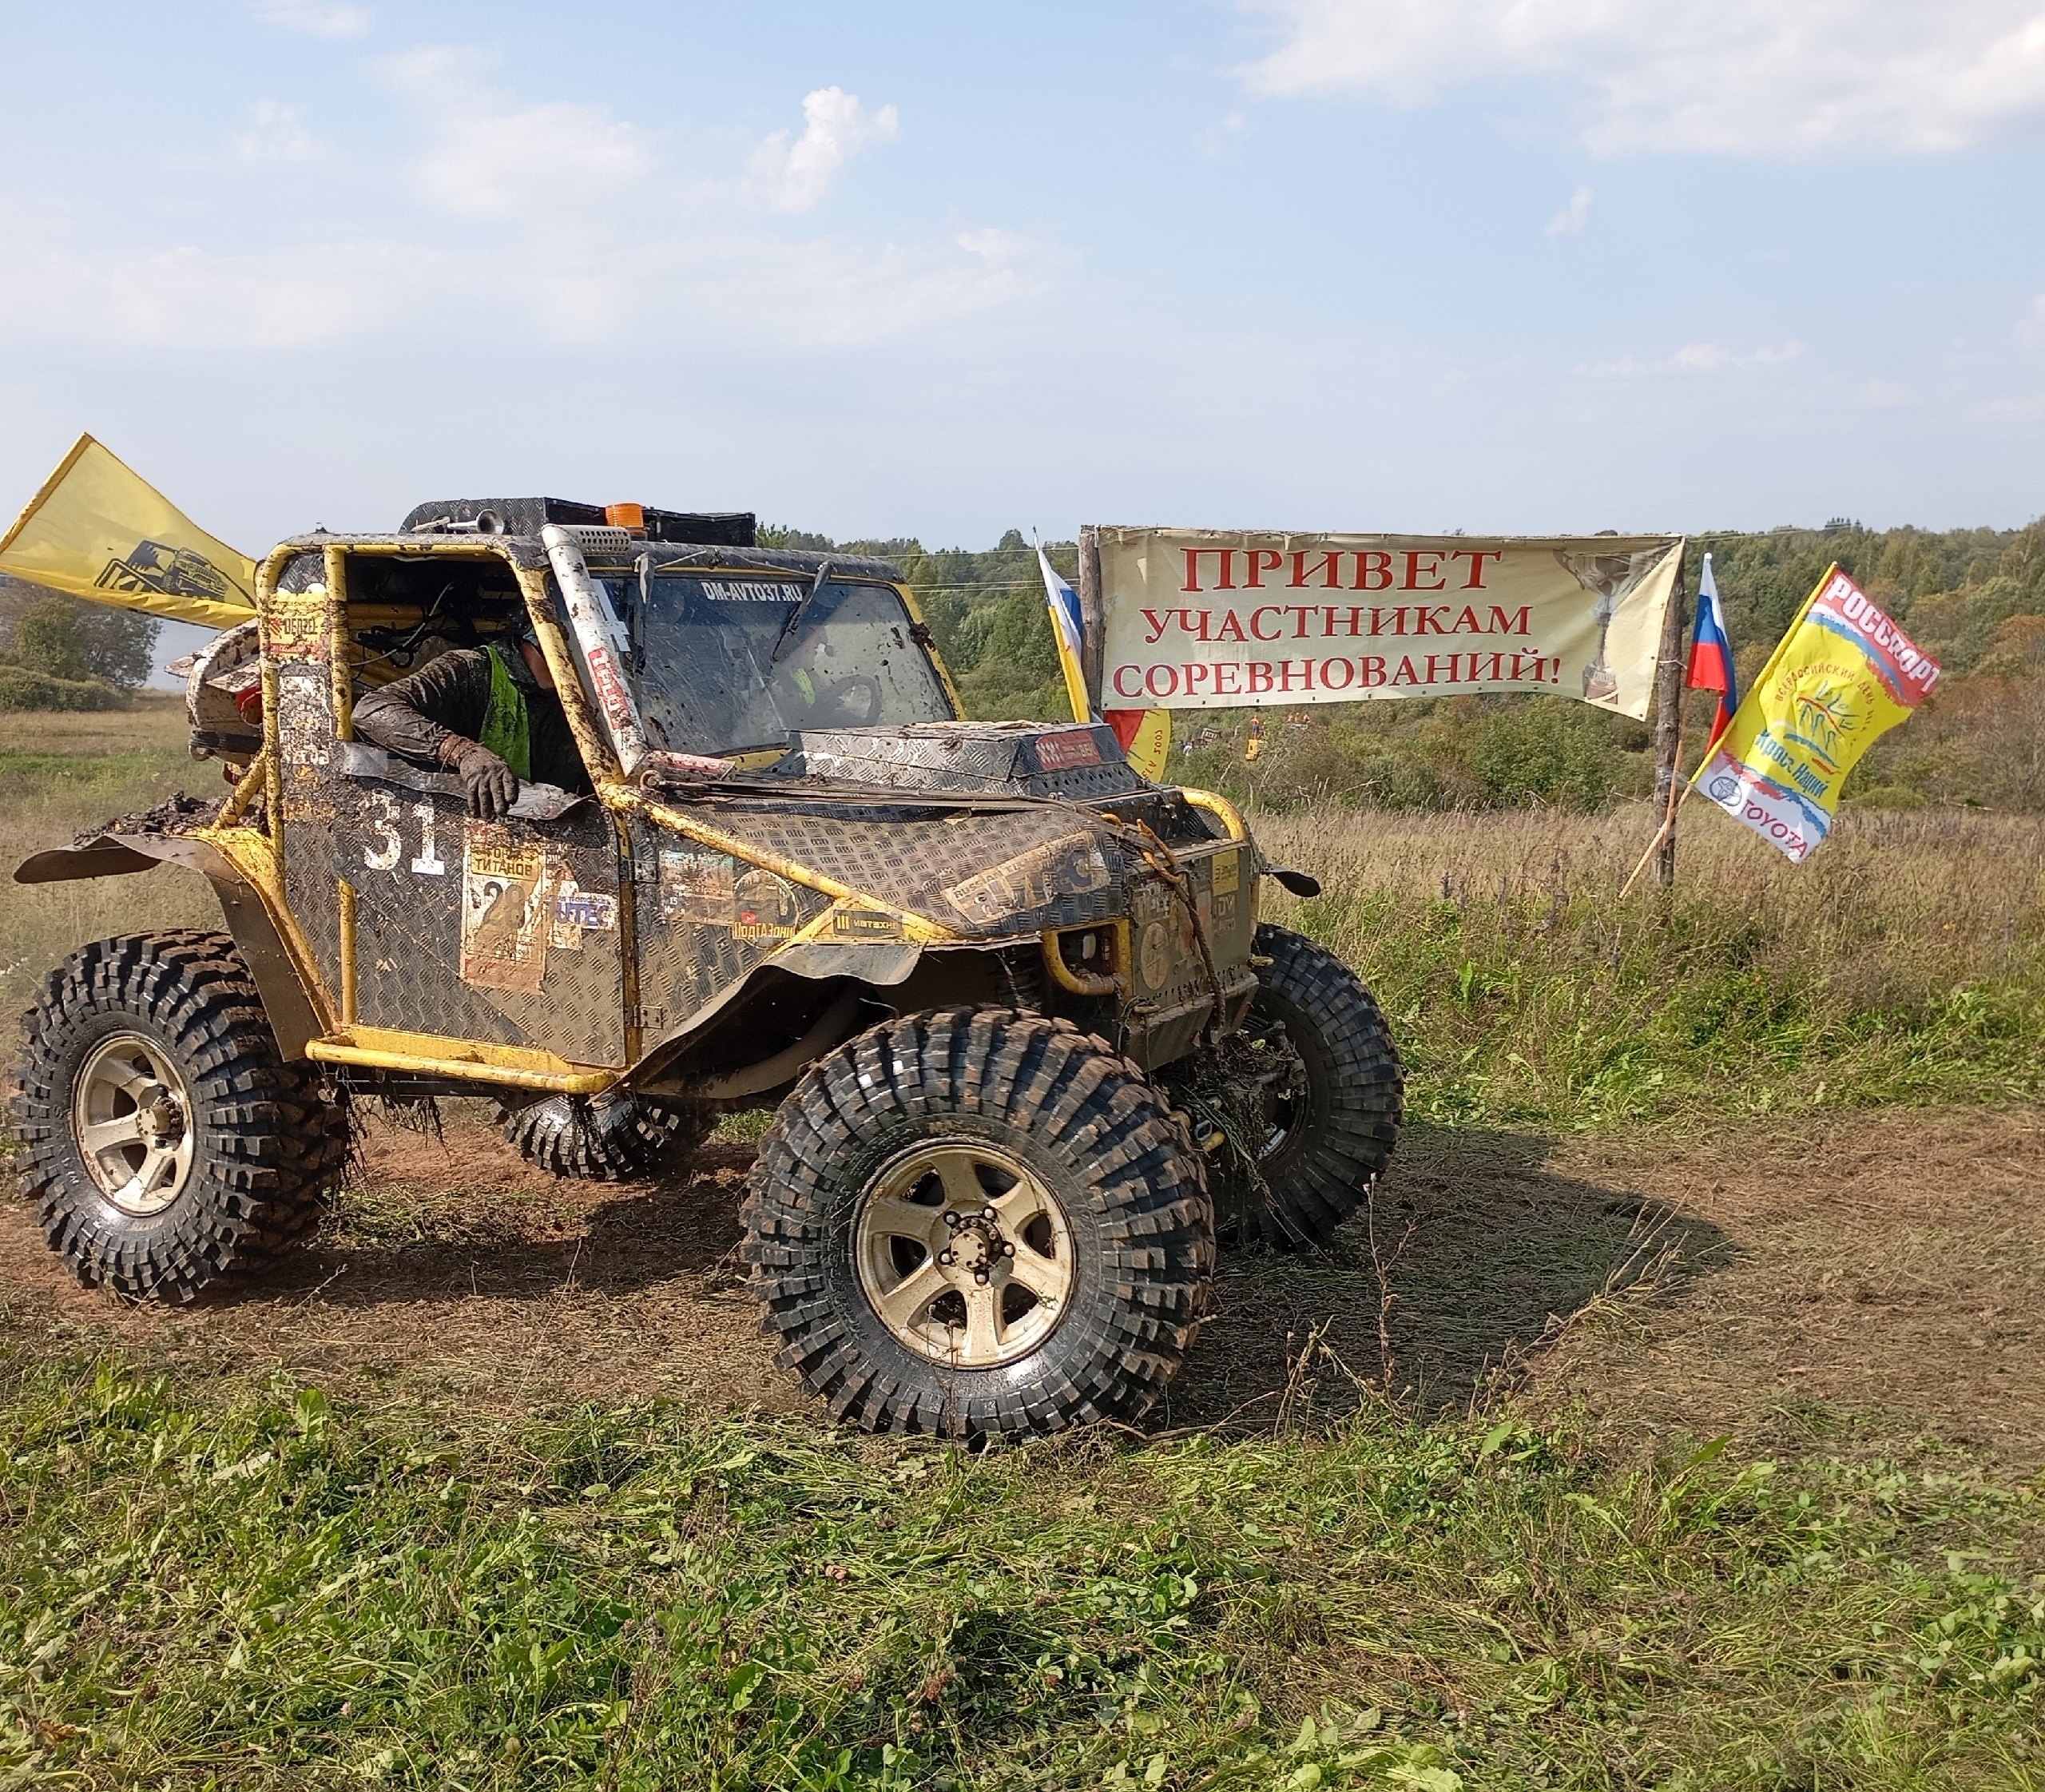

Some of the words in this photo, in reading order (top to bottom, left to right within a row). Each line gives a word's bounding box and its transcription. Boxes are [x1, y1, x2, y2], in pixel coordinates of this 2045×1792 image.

[1178, 546, 1502, 593] ПРИВЕТ
[701, 582, 803, 602] DM-AVTO37.RU
[1139, 604, 1532, 646] УЧАСТНИКАМ
[1113, 646, 1562, 698] СОРЕВНОВАНИЙ!
[1792, 762, 1829, 799] Наций
[361, 788, 445, 876] 31
[1742, 799, 1809, 858] TOYOTA
[475, 857, 534, 876] ТИТАНОВ
